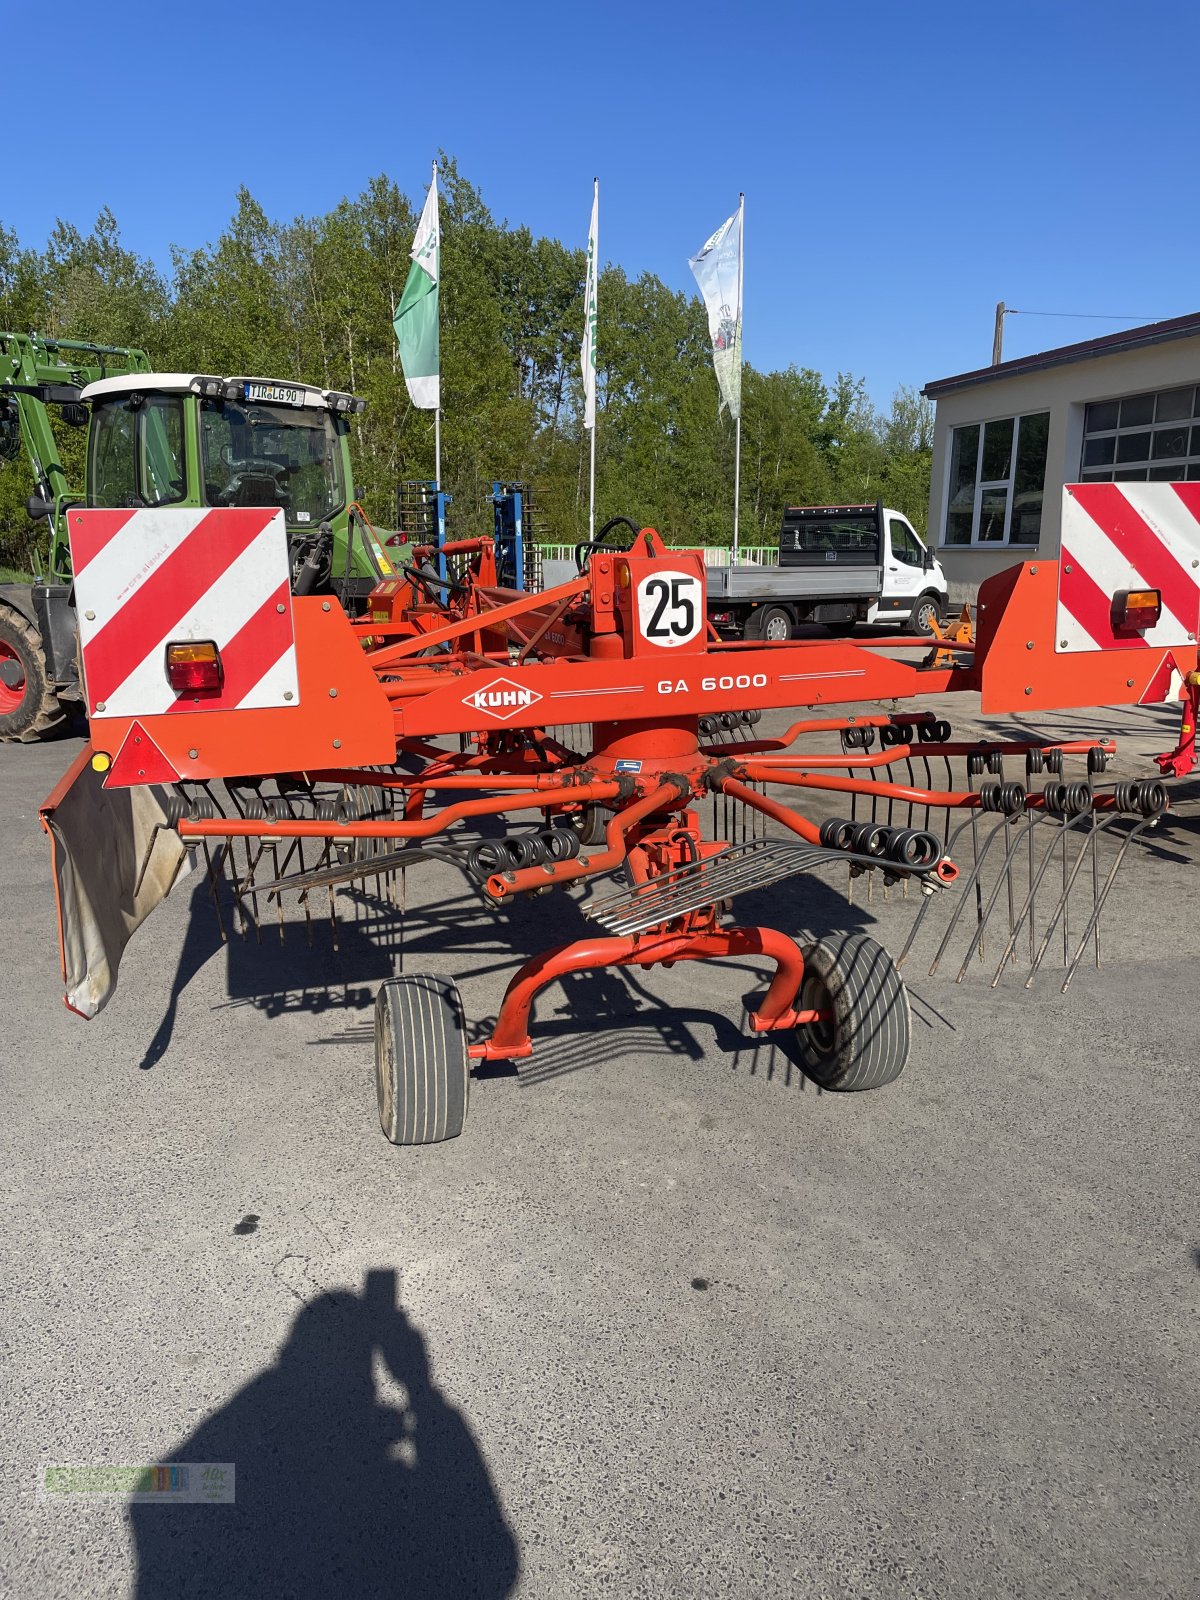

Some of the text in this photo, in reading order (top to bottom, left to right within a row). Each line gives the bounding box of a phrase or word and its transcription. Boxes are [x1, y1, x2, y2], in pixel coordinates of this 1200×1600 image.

[251, 385, 267, 399] TIR
[273, 387, 285, 401] LG
[286, 389, 297, 402] 90
[645, 578, 695, 637] 25
[657, 674, 767, 694] GA 6000
[474, 690, 531, 708] KUHN
